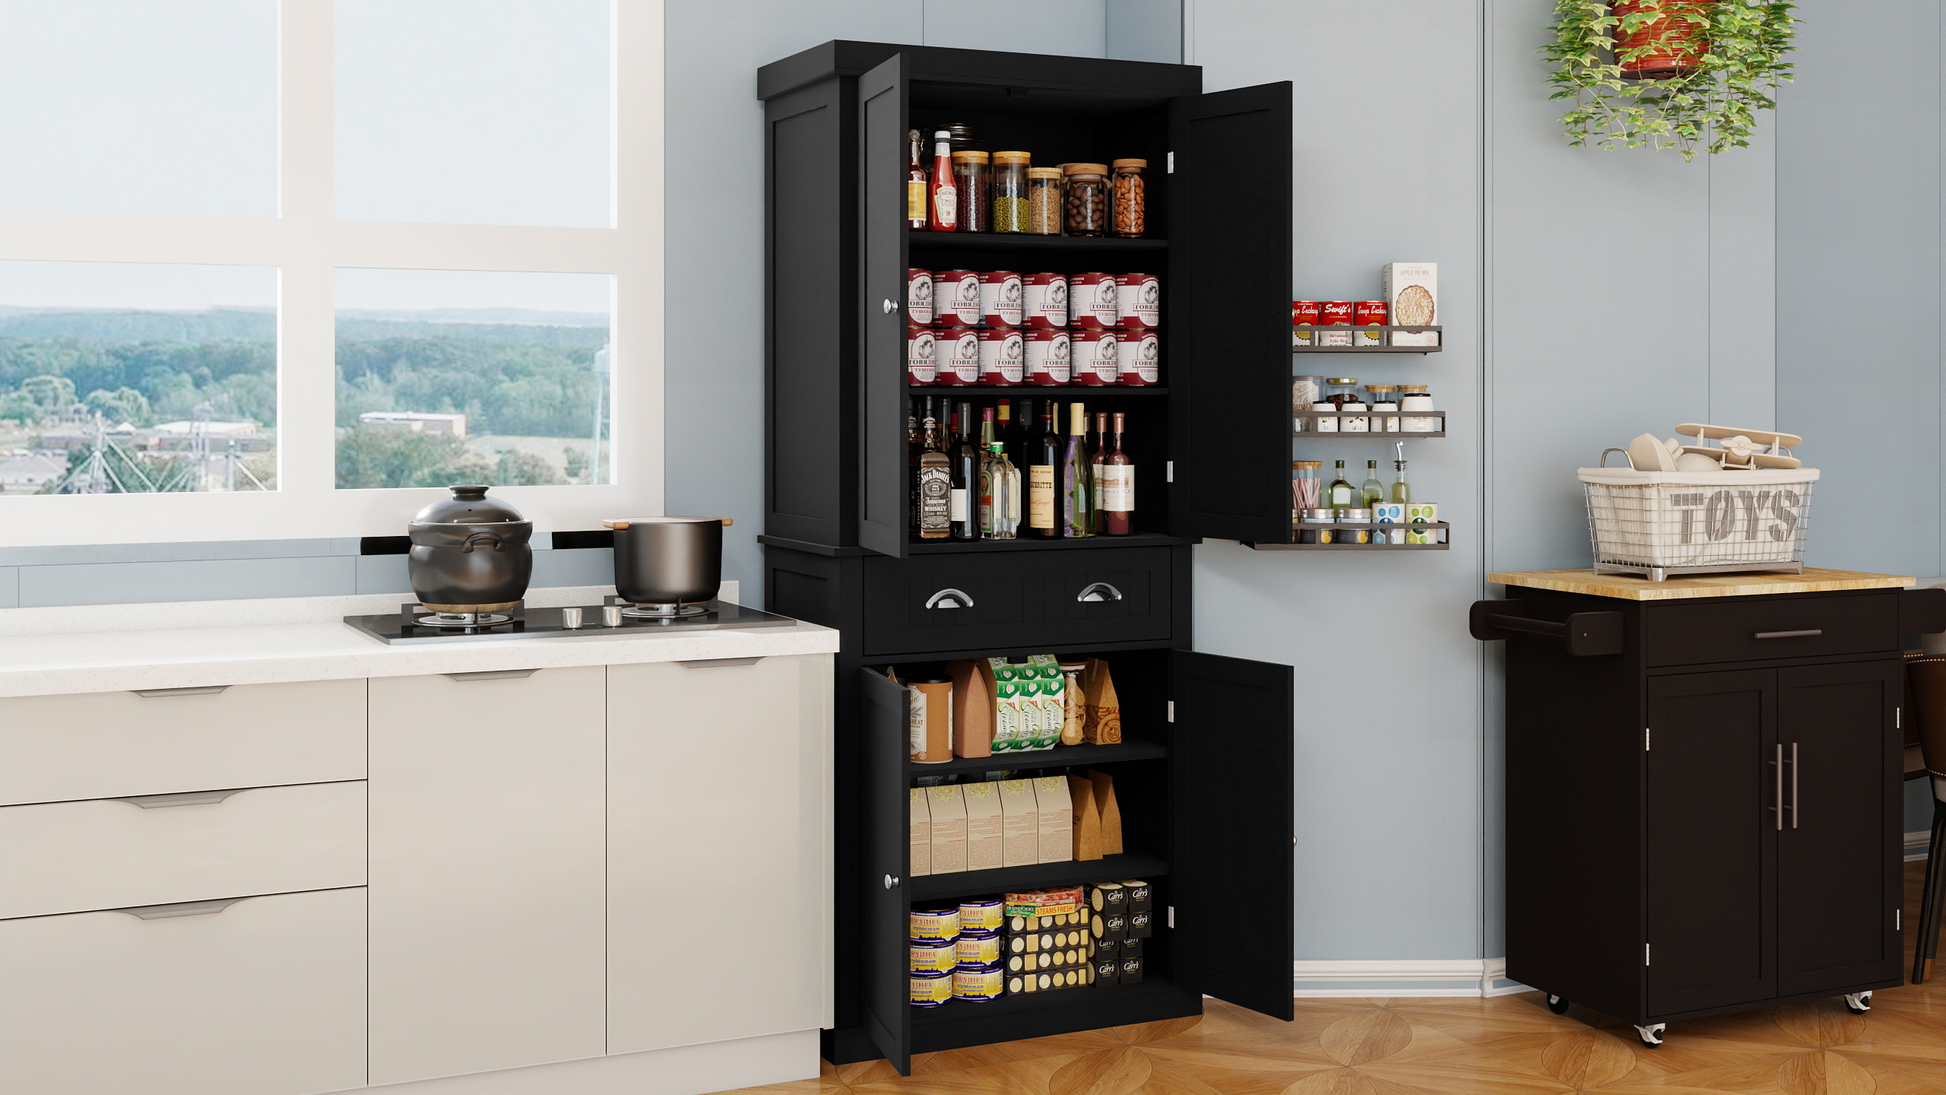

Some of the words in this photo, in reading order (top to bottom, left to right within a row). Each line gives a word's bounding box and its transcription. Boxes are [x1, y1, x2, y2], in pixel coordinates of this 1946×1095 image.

[1324, 303, 1351, 315] Swift's
[921, 472, 933, 484] JACK
[1670, 489, 1800, 544] TOYS
[1108, 890, 1123, 901] Carr's
[1132, 888, 1148, 898] Carr's
[1036, 907, 1057, 915] STEAMS
[1057, 905, 1073, 913] FRESH
[1108, 917, 1123, 928] Carr's
[1132, 915, 1148, 925] Carr's
[1099, 964, 1115, 974] Carr's
[1123, 960, 1139, 971] Carr's
